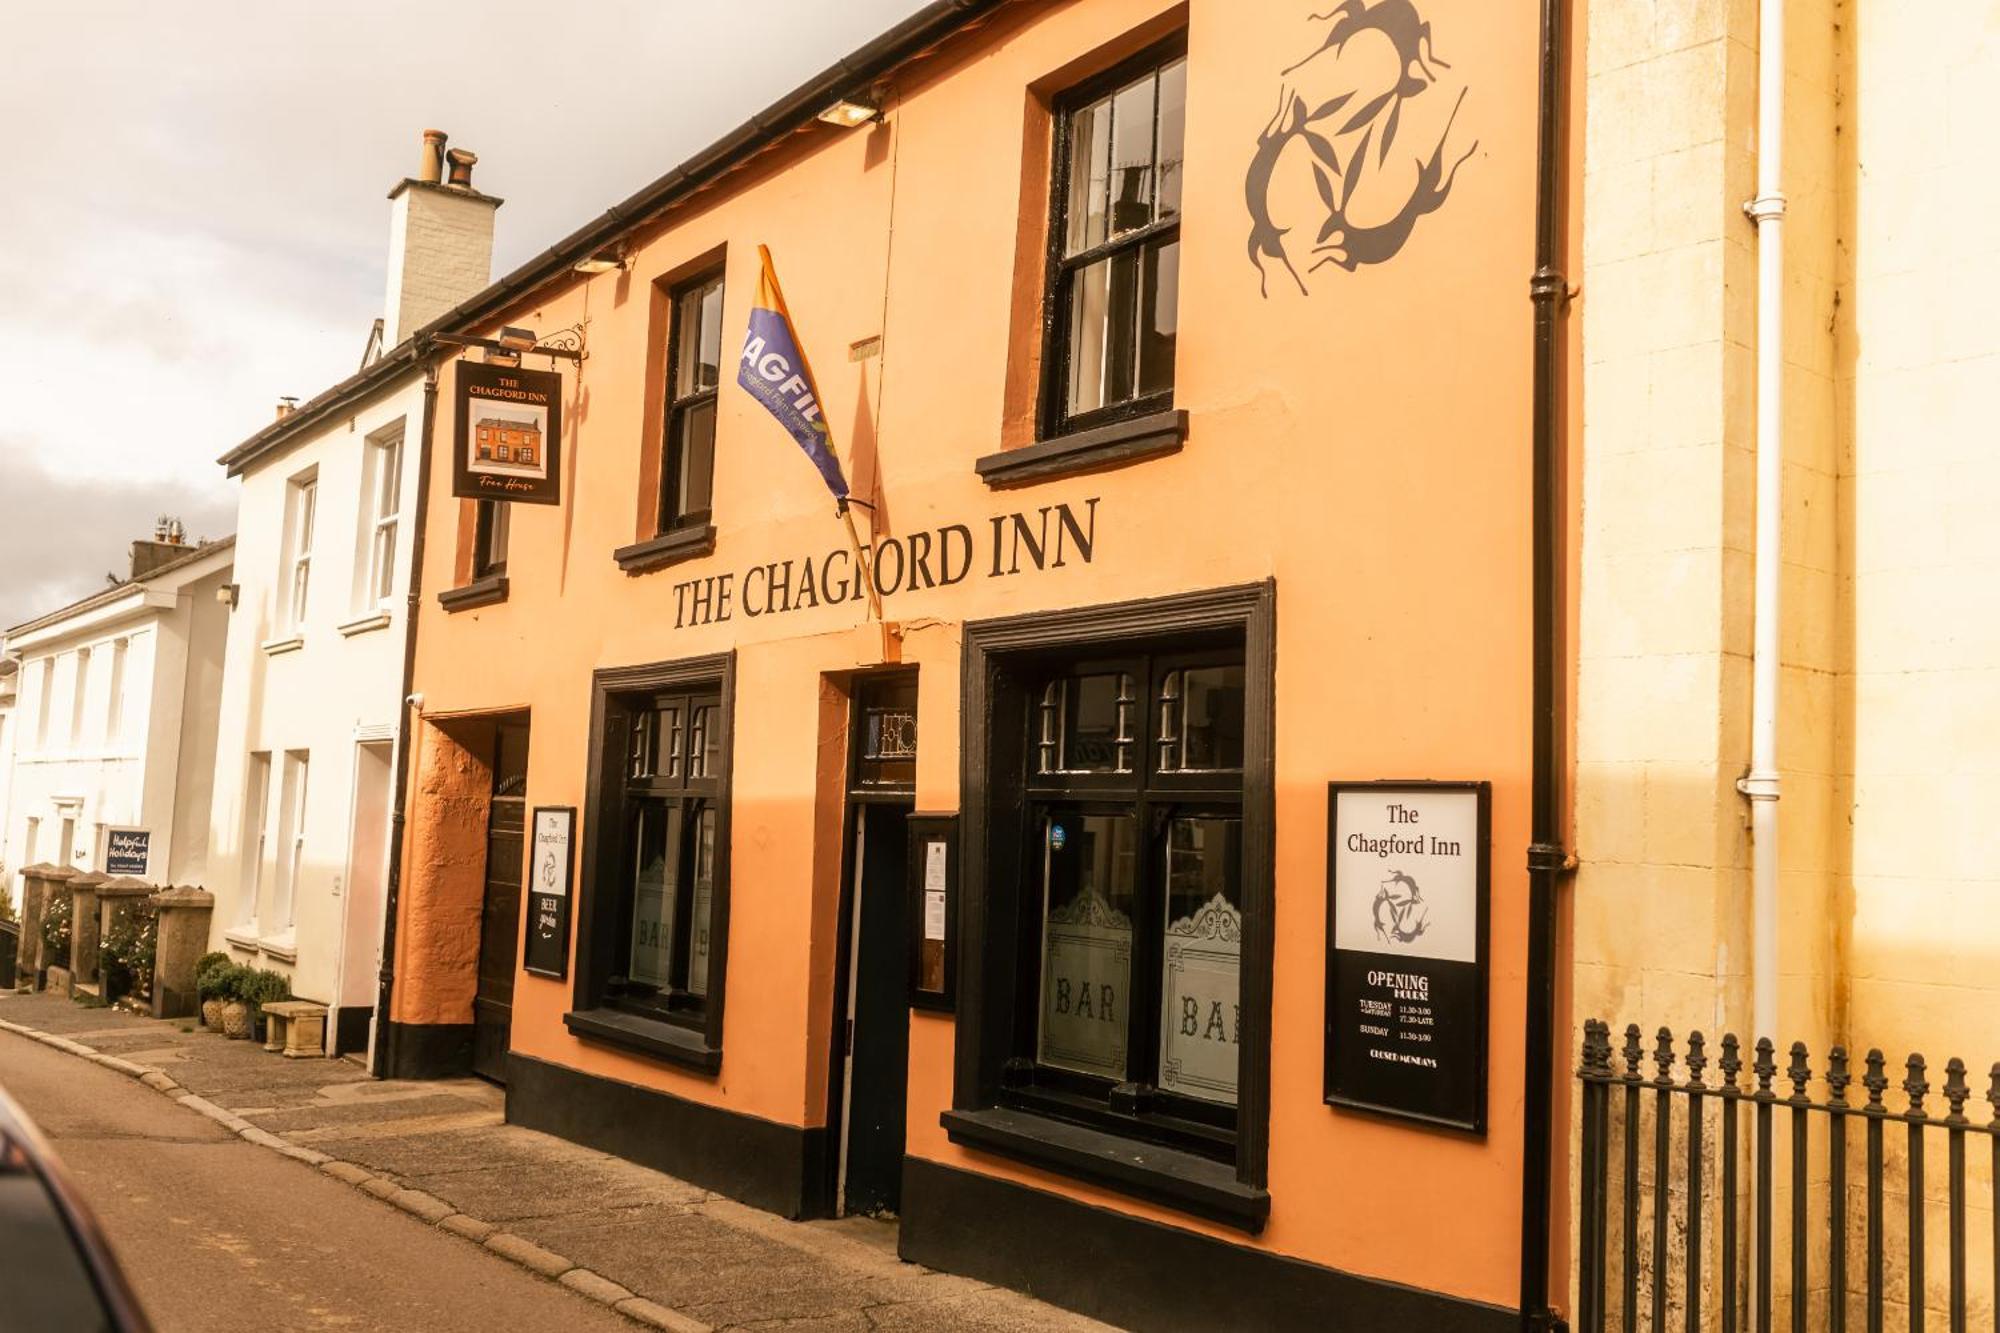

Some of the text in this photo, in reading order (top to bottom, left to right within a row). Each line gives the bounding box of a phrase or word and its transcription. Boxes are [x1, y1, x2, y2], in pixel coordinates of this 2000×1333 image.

[498, 378, 518, 387] THE
[470, 385, 547, 402] CHAGFORD INN
[480, 476, 534, 490] Free House
[673, 573, 734, 629] THE
[987, 497, 1100, 578] INN
[1386, 804, 1419, 824] The
[113, 833, 147, 849] Helpful
[1347, 833, 1462, 858] Chagford Inn
[109, 848, 146, 861] Holidays
[1367, 971, 1428, 990] OPENING
[1056, 978, 1115, 1023] BAR
[1360, 1000, 1392, 1010] TUESDAY
[1360, 1025, 1388, 1036] SUNDAY
